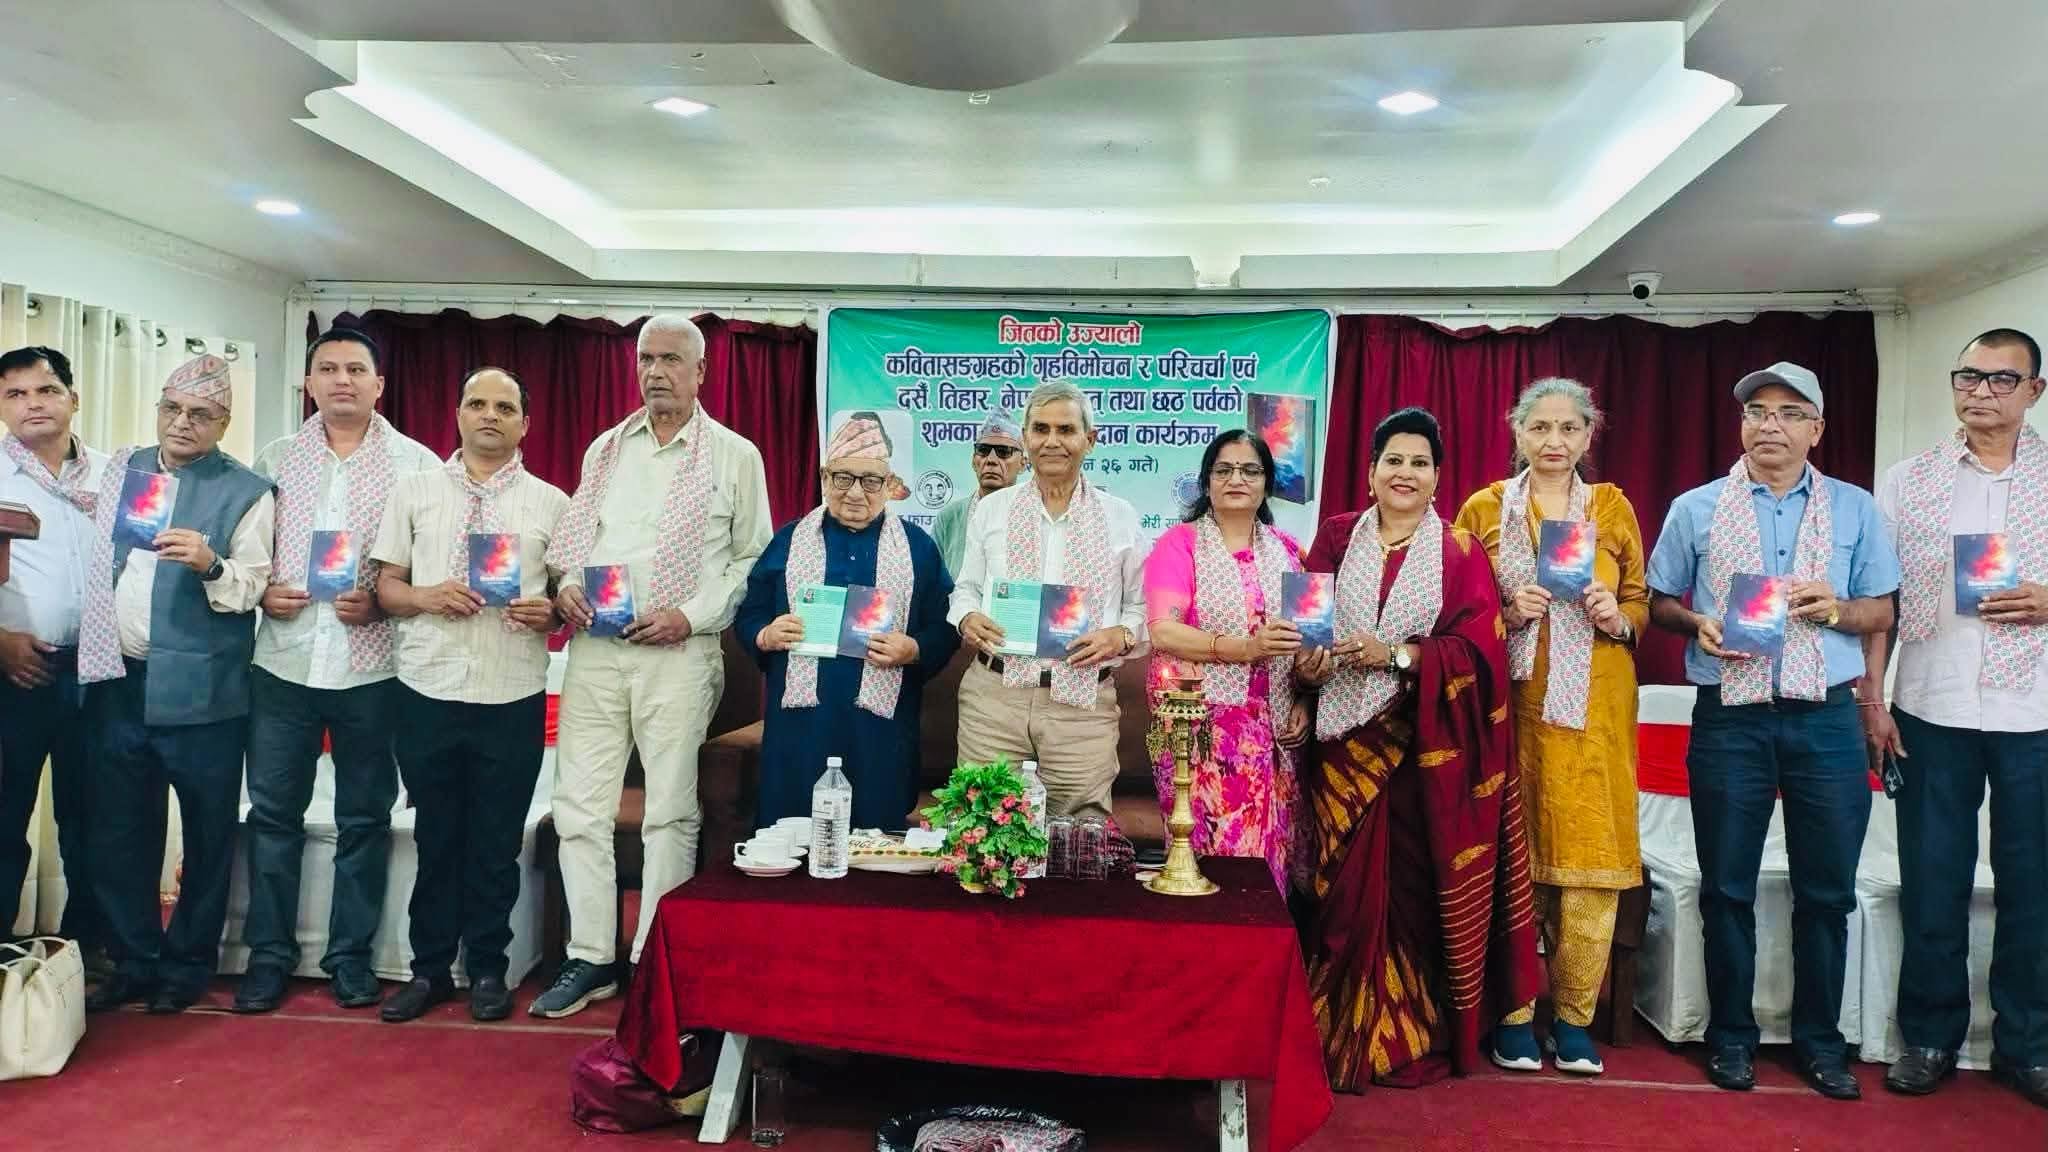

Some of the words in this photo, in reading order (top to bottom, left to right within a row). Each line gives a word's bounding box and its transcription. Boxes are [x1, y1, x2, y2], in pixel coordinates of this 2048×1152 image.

[1000, 317, 1062, 342] जितको
[1068, 321, 1141, 344] उज्यालो
[886, 348, 1026, 380] कवितासङ्ग्रहको
[1033, 350, 1131, 382] गृहविमोचन
[1137, 357, 1151, 378] र
[1157, 350, 1225, 379] परिचर्चा
[1232, 352, 1258, 379] एवं
[1109, 390, 1146, 411] तथा
[1152, 391, 1186, 412] छठ
[1192, 386, 1243, 412] पर्वको
[921, 421, 983, 447] शुभका
[1136, 419, 1218, 447] कार्यक्रम
[1101, 458, 1122, 475] २६
[1128, 455, 1159, 474] गते)
[1142, 514, 1162, 529] भेरी
